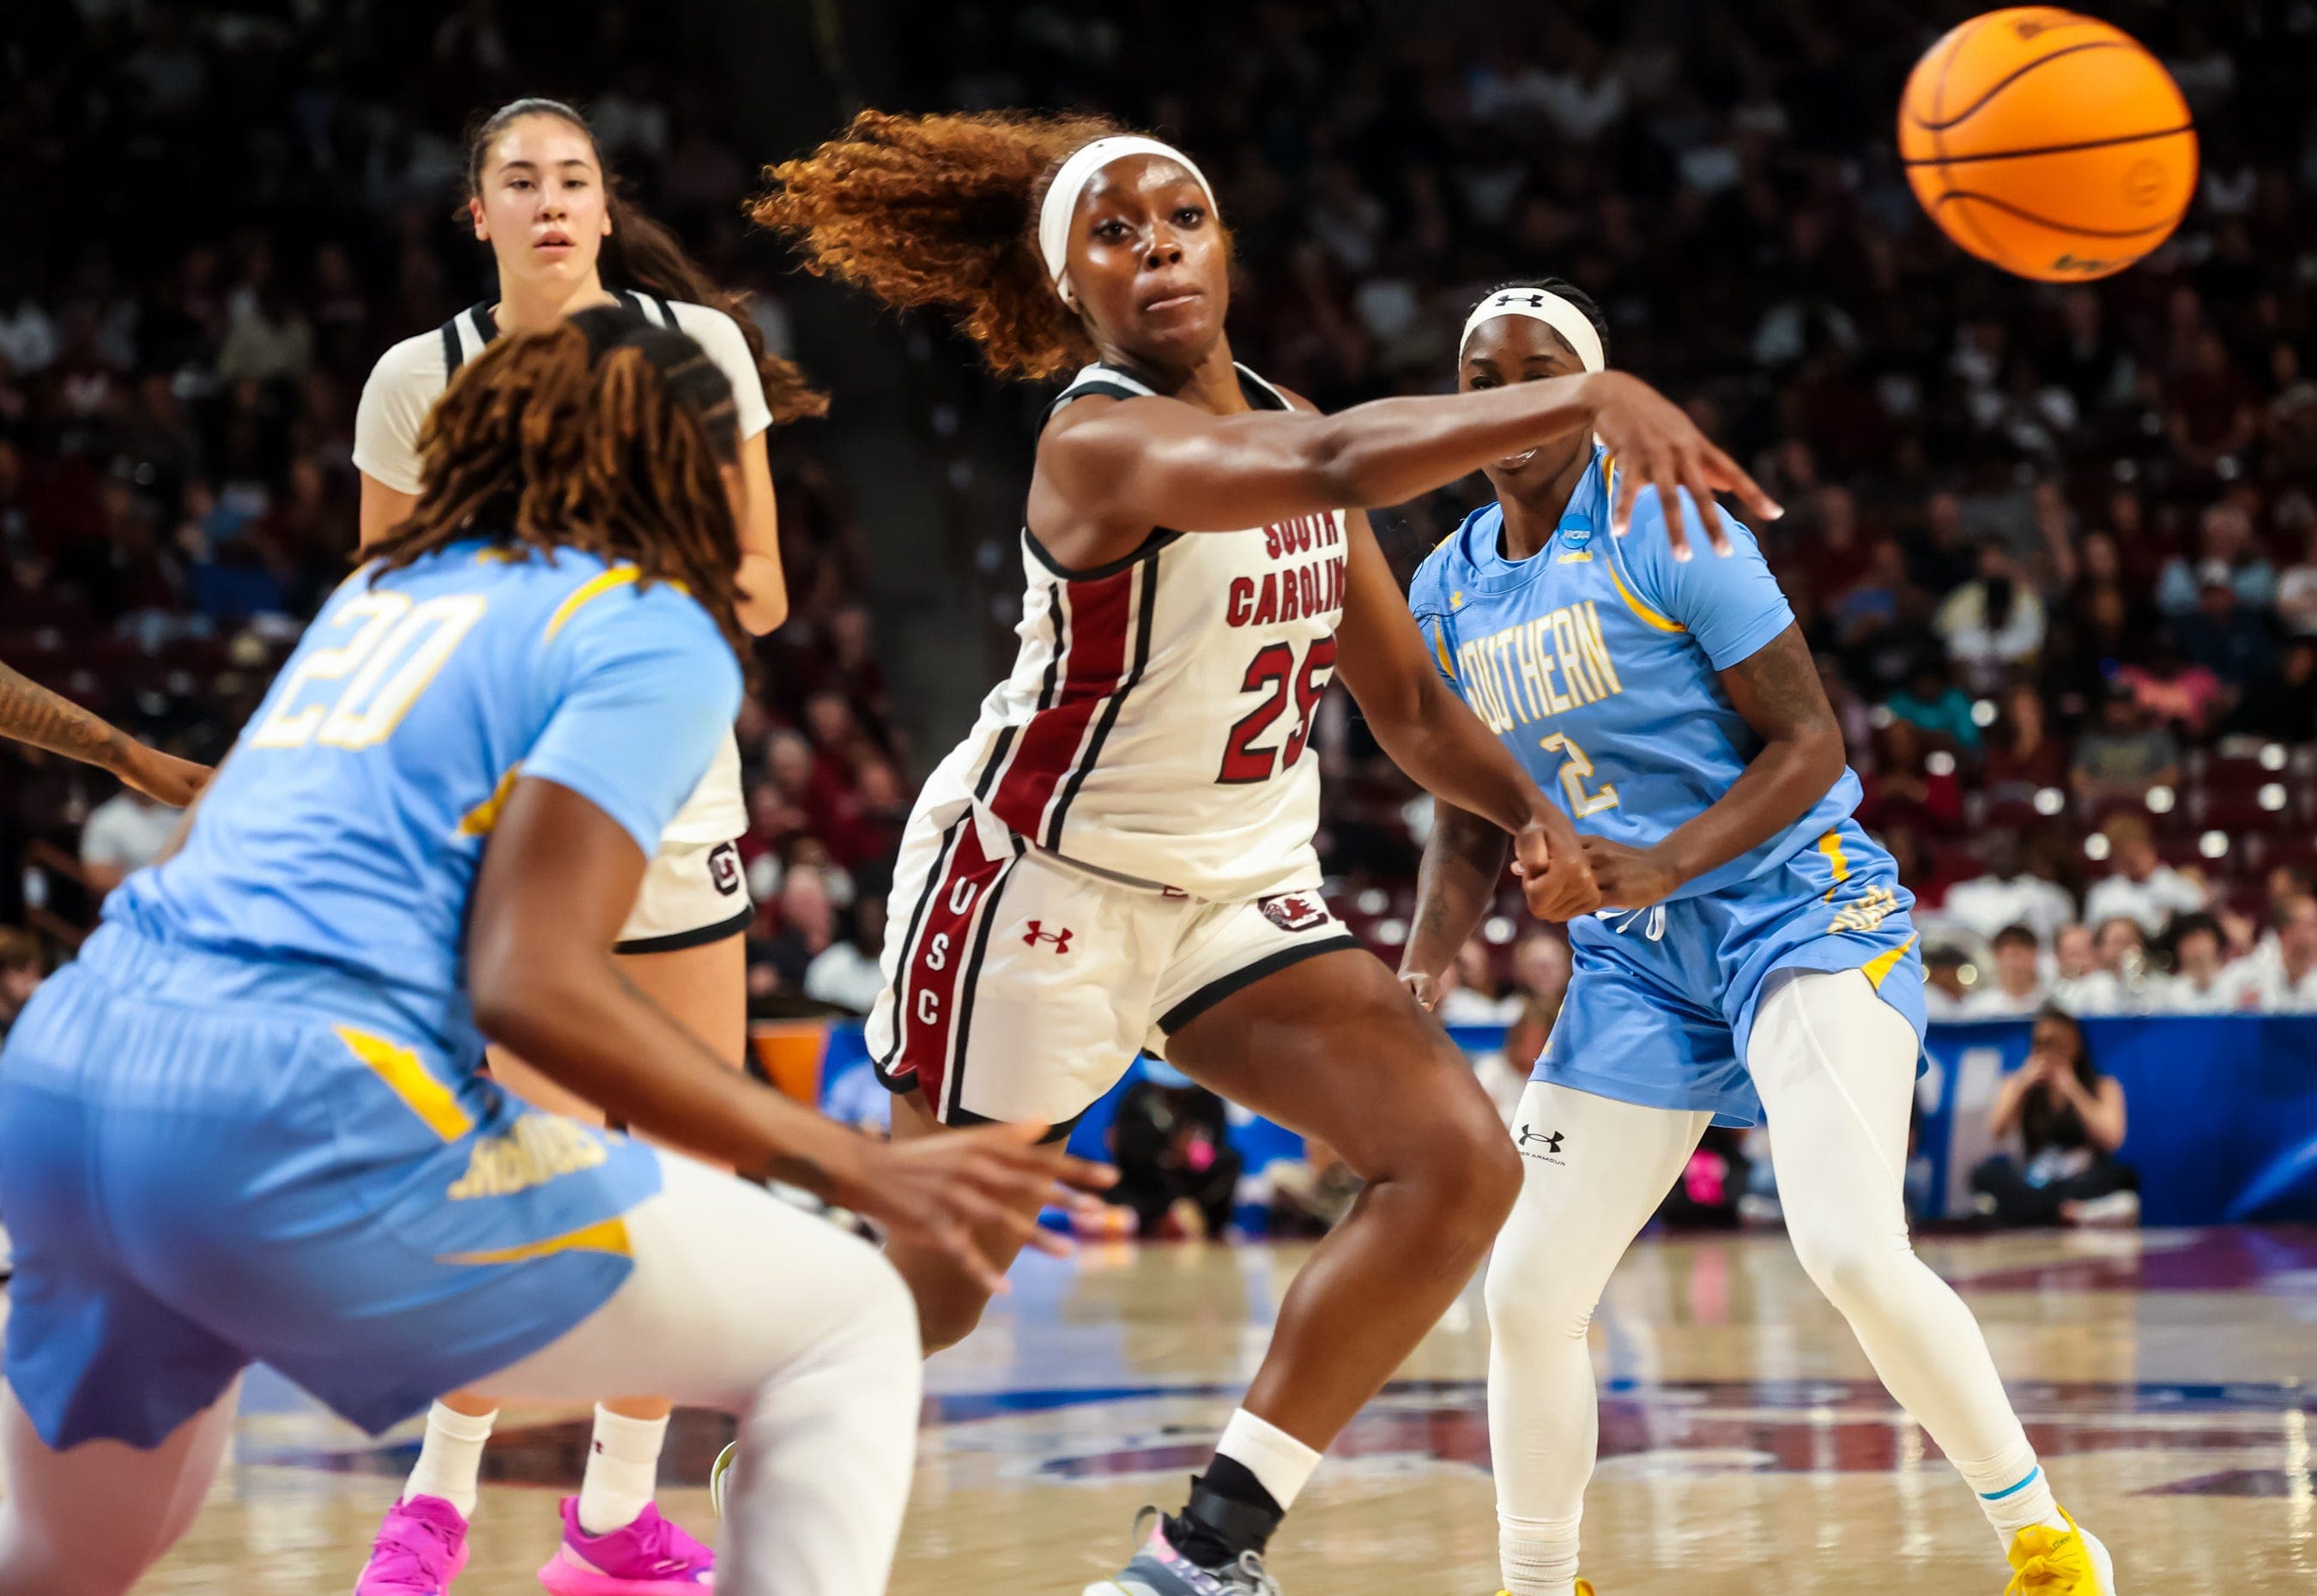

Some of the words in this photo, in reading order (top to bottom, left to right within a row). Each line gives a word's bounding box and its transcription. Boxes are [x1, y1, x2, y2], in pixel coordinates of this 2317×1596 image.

[1226, 555, 1346, 627] CAROLIN
[250, 589, 486, 751] 20
[1214, 633, 1337, 784] 25
[1540, 731, 1619, 819] 2
[917, 876, 978, 1025] USC
